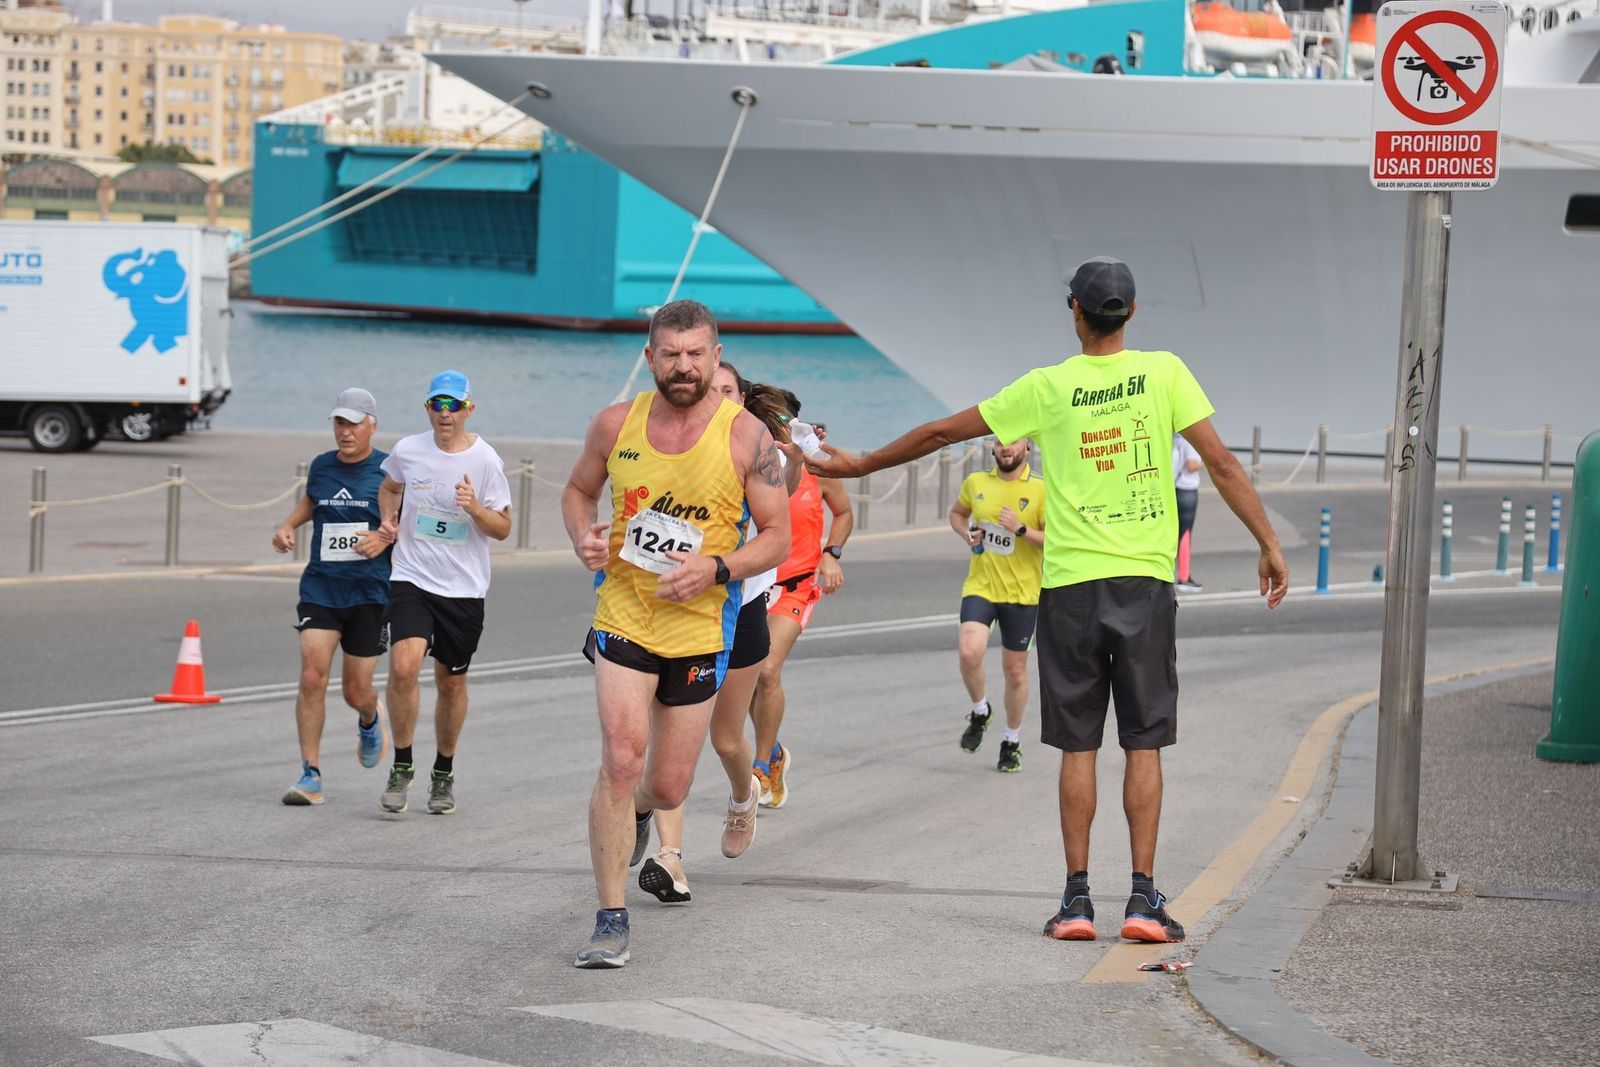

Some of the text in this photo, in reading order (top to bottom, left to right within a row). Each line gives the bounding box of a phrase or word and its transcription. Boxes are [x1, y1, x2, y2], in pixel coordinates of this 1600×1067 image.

[1390, 134, 1481, 152] PROHIBIDO
[1376, 157, 1493, 175] USAR DRONES
[1071, 374, 1146, 407] CARRERA 5K
[1091, 402, 1131, 418] MÁLAGA
[1081, 426, 1122, 444] DONACIÓN
[1079, 441, 1127, 460] TRASPLANTE
[1096, 459, 1115, 472] VIDA
[649, 491, 711, 521] Álora
[435, 521, 447, 534] 5
[329, 536, 359, 550] 288
